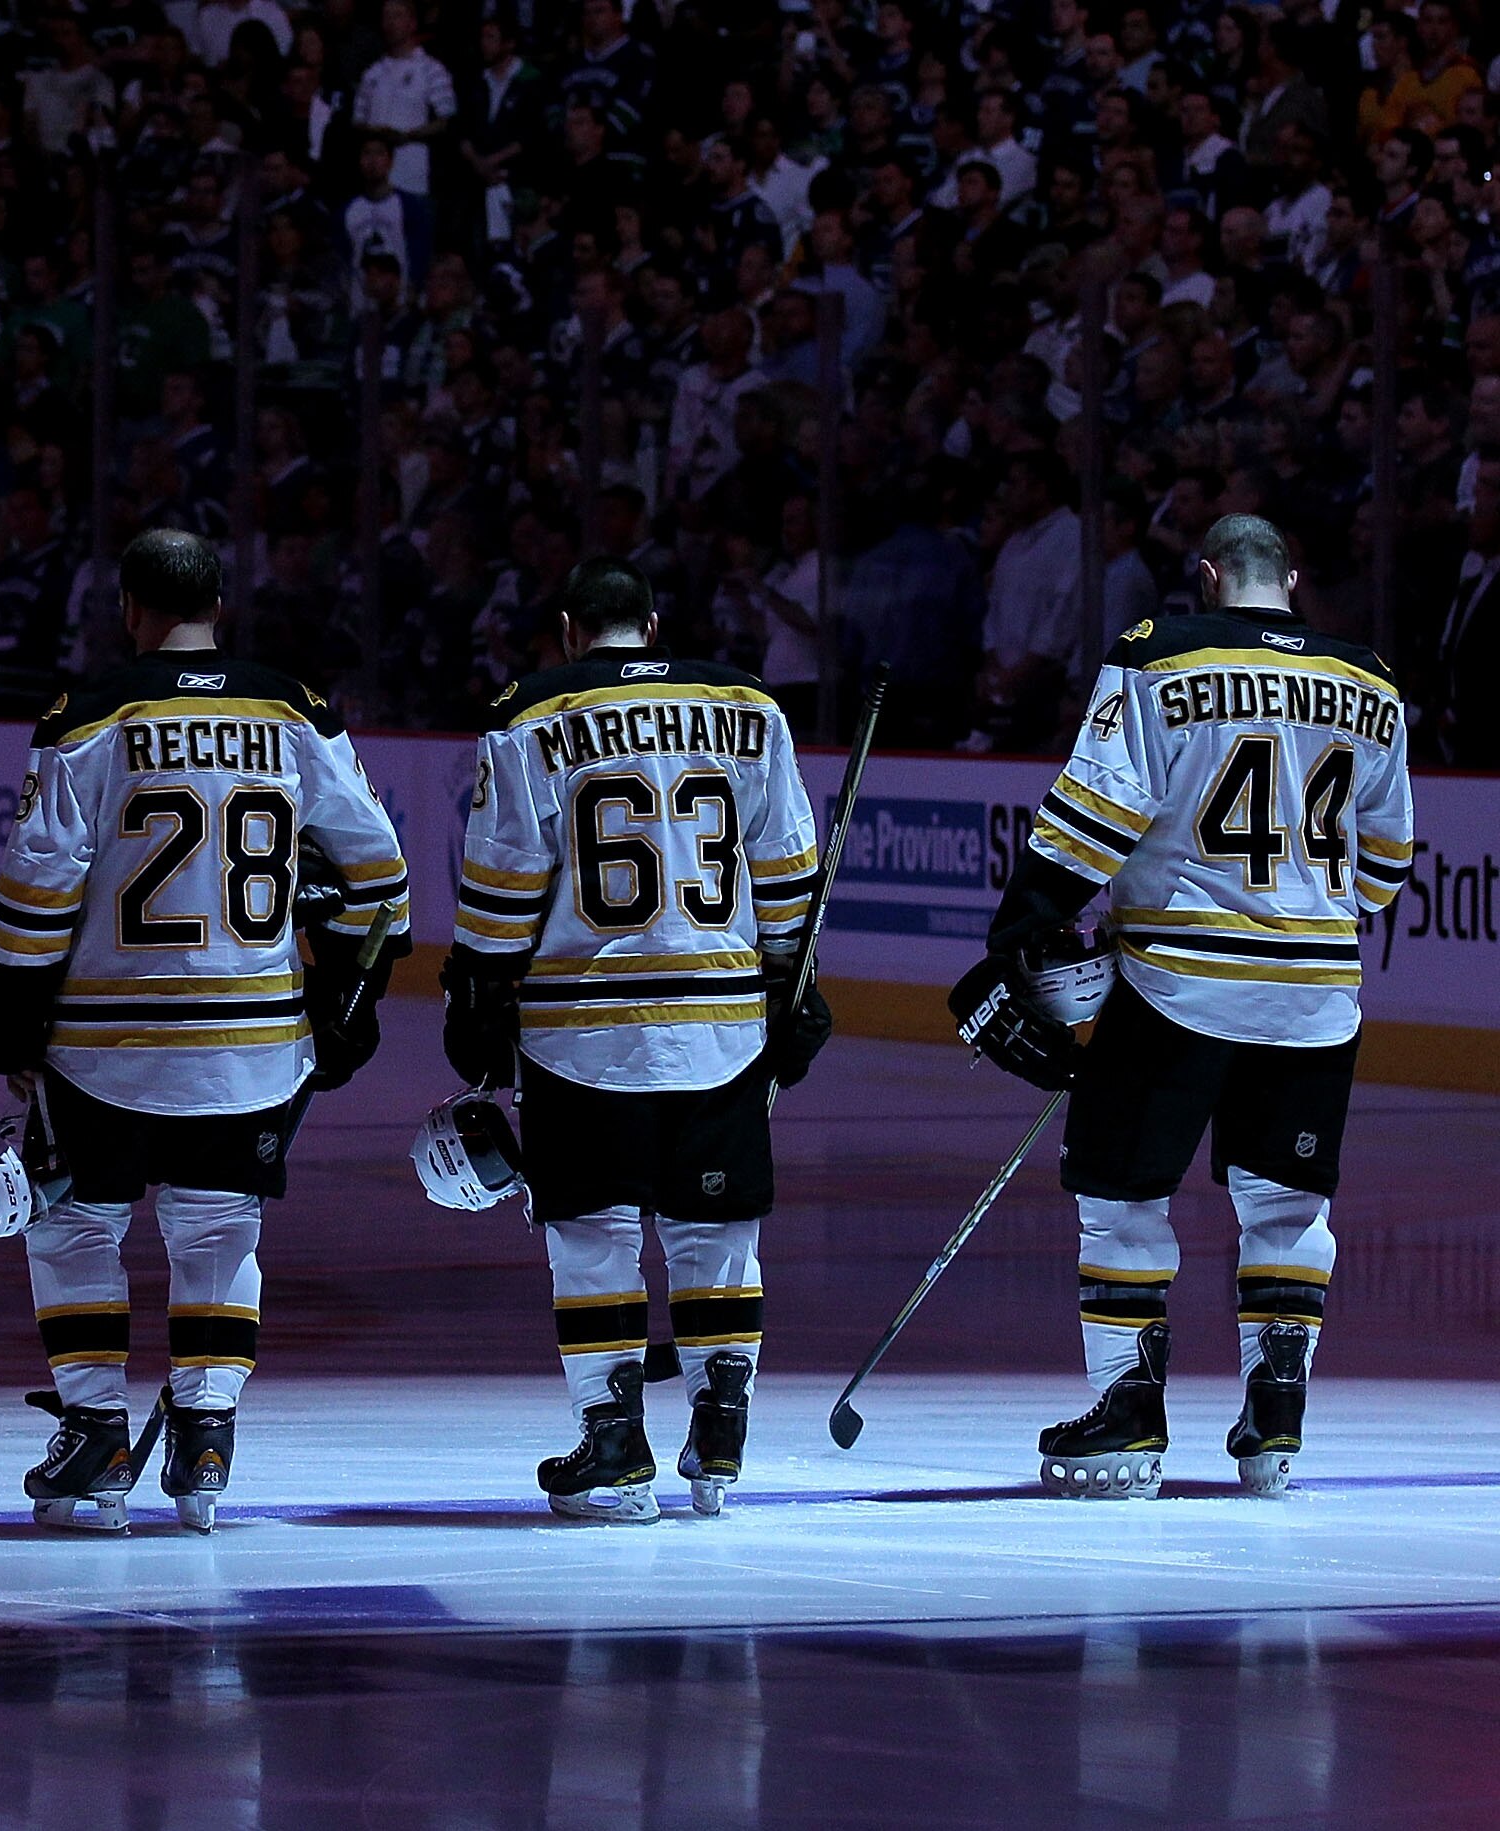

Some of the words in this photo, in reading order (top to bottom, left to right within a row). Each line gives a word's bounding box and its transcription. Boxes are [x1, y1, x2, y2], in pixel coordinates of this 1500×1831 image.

[531, 704, 769, 775] MARCHAND
[1157, 670, 1401, 750] SEIDENBERG
[123, 720, 285, 774] RECCHI
[876, 808, 982, 876] Province
[1192, 732, 1358, 898] 44
[116, 784, 298, 952] 28
[573, 769, 744, 933] 63
[2, 1171, 18, 1207] CCM
[202, 1470, 220, 1484] 28
